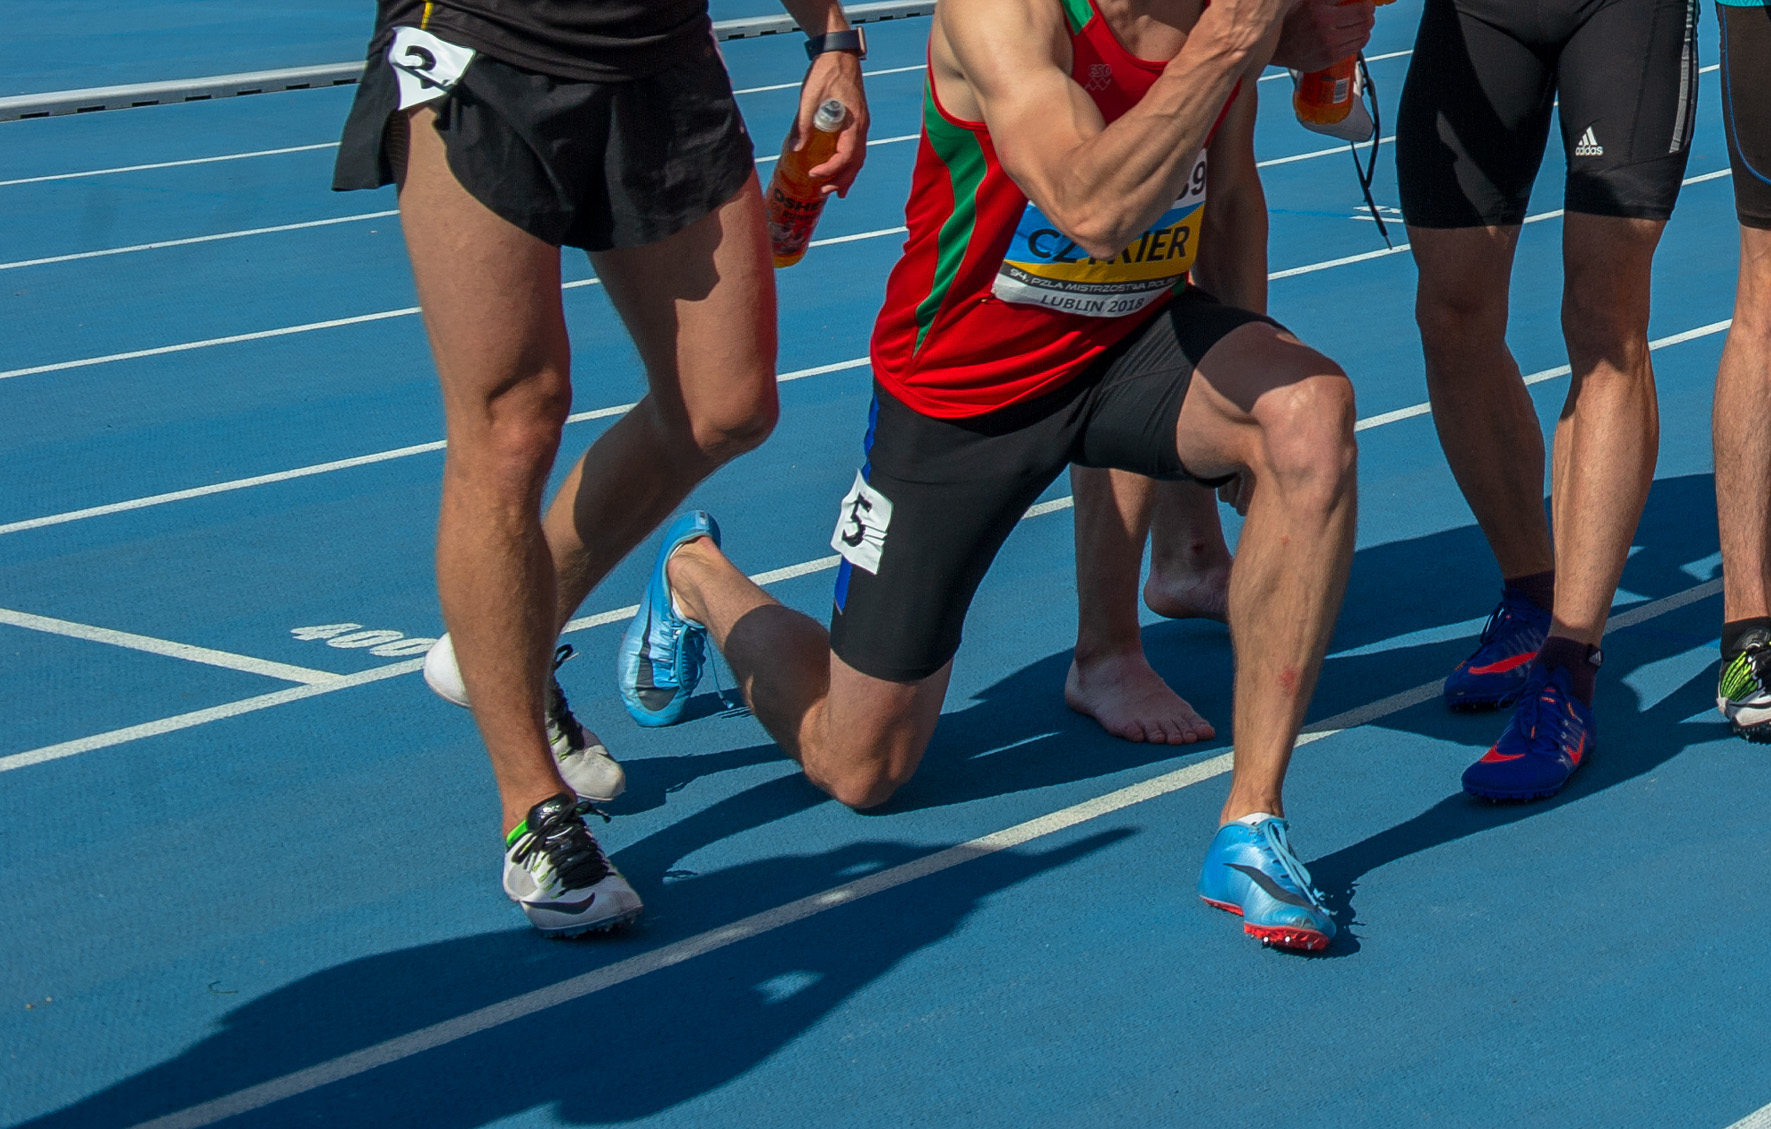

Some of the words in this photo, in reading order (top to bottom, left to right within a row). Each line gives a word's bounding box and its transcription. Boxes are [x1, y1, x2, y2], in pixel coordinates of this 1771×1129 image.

[1575, 145, 1604, 156] adidas
[1030, 276, 1063, 290] PZLA
[1065, 282, 1147, 294] MISTRZOSTWA
[1040, 294, 1105, 313] LUBLIN
[1107, 297, 1146, 313] 2018
[841, 491, 873, 548] 5
